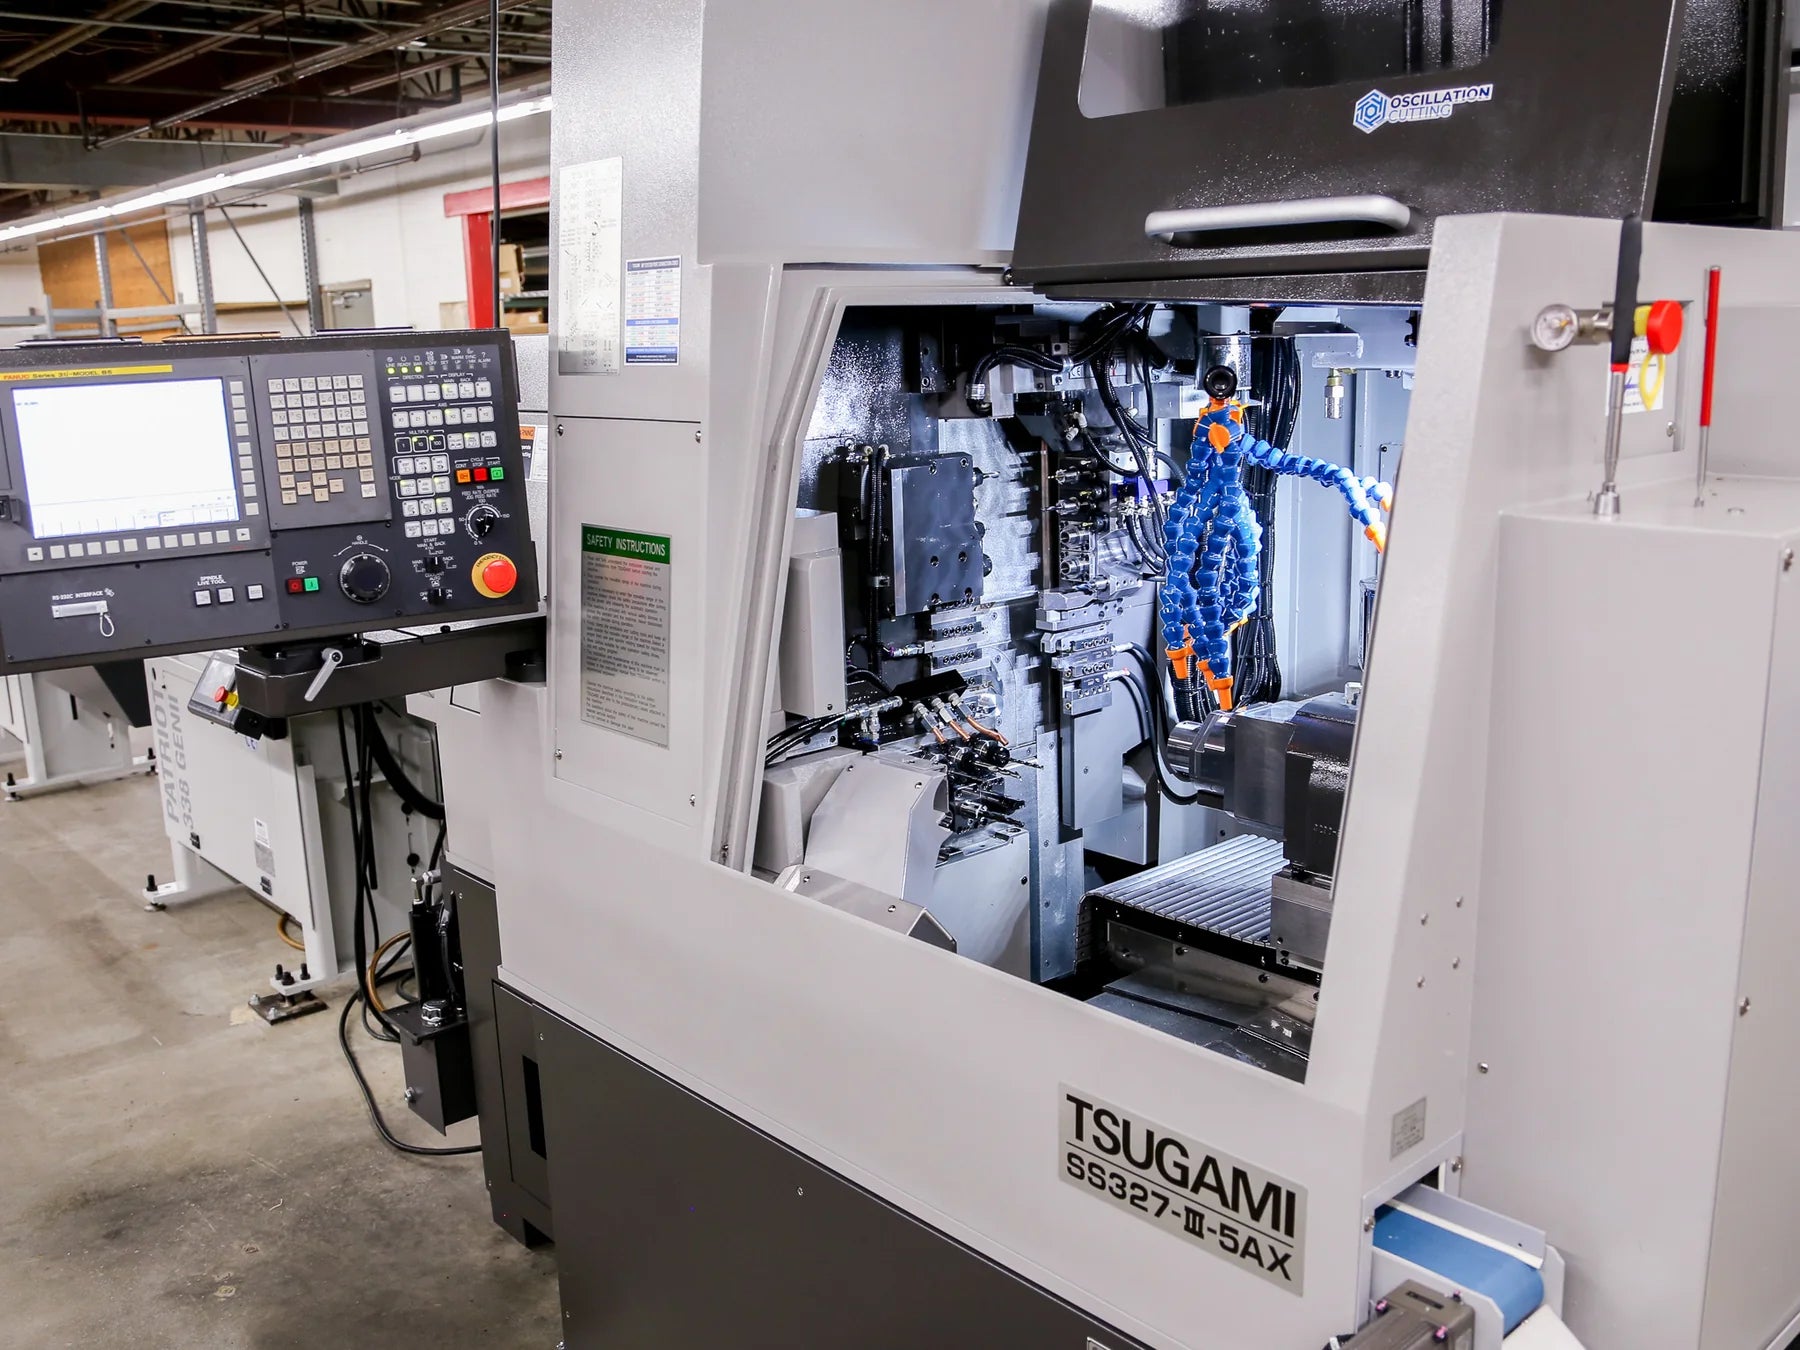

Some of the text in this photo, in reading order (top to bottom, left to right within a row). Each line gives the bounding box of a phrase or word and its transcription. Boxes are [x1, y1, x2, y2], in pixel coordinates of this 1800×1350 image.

[1388, 104, 1451, 122] CUTTING
[1390, 86, 1490, 108] OSCILLATION
[586, 534, 666, 556] SAFETY INSTRUCTIONS
[153, 684, 180, 824] PATRIOT
[168, 695, 194, 830] 338 GENII
[1066, 1094, 1296, 1238] TSUGAMI
